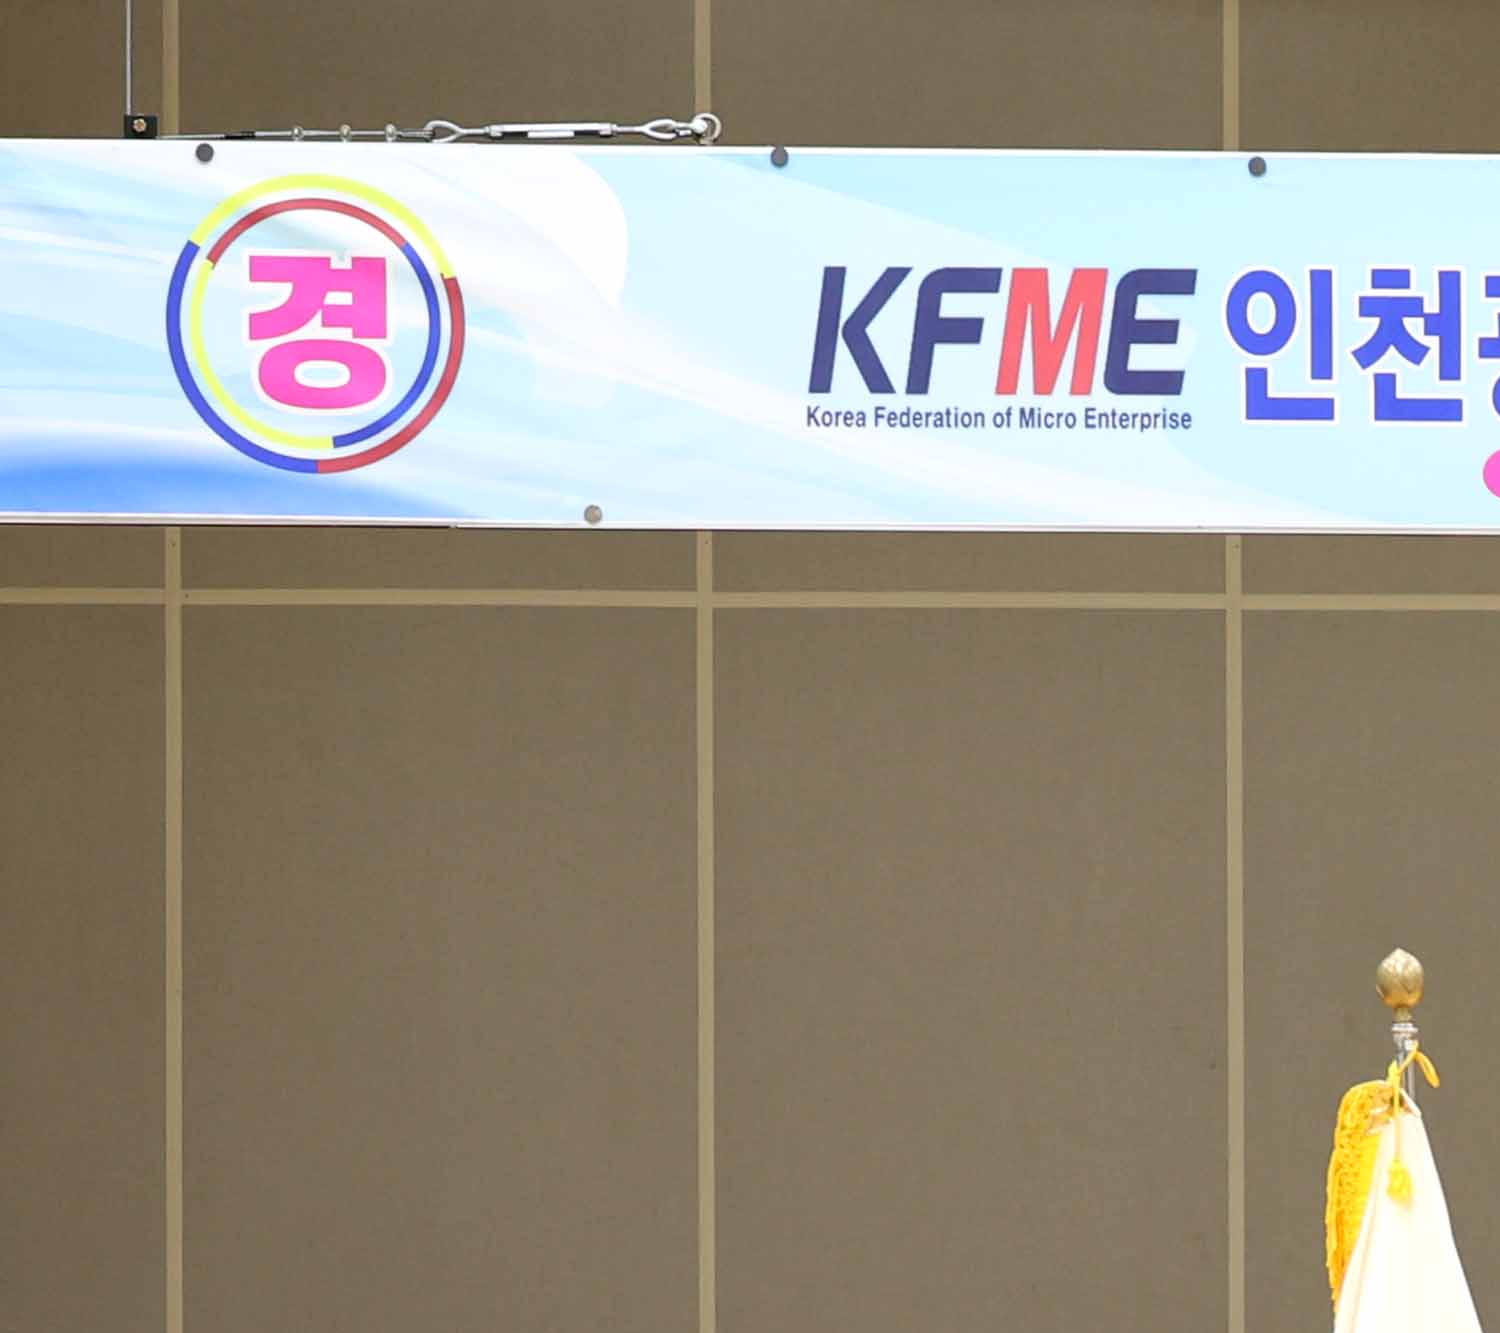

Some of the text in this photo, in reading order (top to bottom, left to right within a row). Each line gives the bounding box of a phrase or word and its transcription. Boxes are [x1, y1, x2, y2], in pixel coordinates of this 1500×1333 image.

[248, 253, 389, 409] 경
[808, 266, 1198, 396] KFME
[807, 406, 1193, 433] Korea Federation of Micro Enterprise
